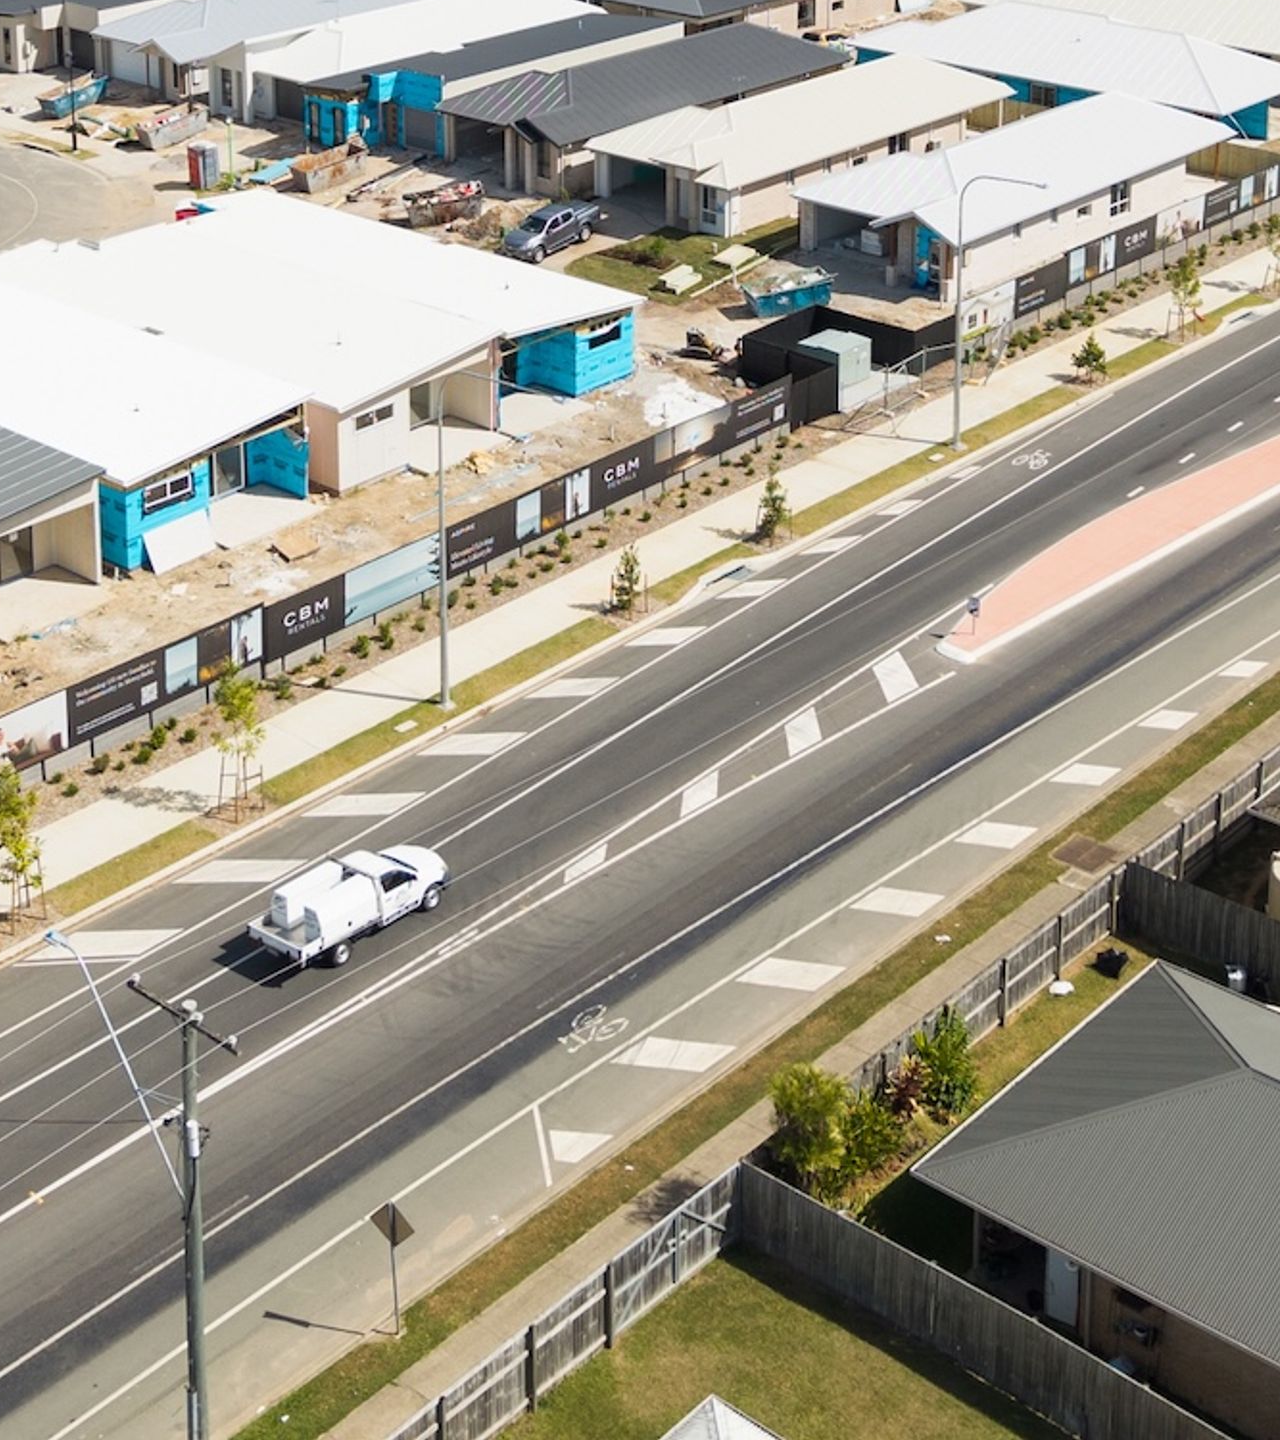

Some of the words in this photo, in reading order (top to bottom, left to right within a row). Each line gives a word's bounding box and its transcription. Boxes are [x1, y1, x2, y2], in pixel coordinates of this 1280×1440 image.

[604, 456, 640, 482] CBM
[283, 596, 329, 627] CBM
[287, 613, 326, 635] RENTALS
